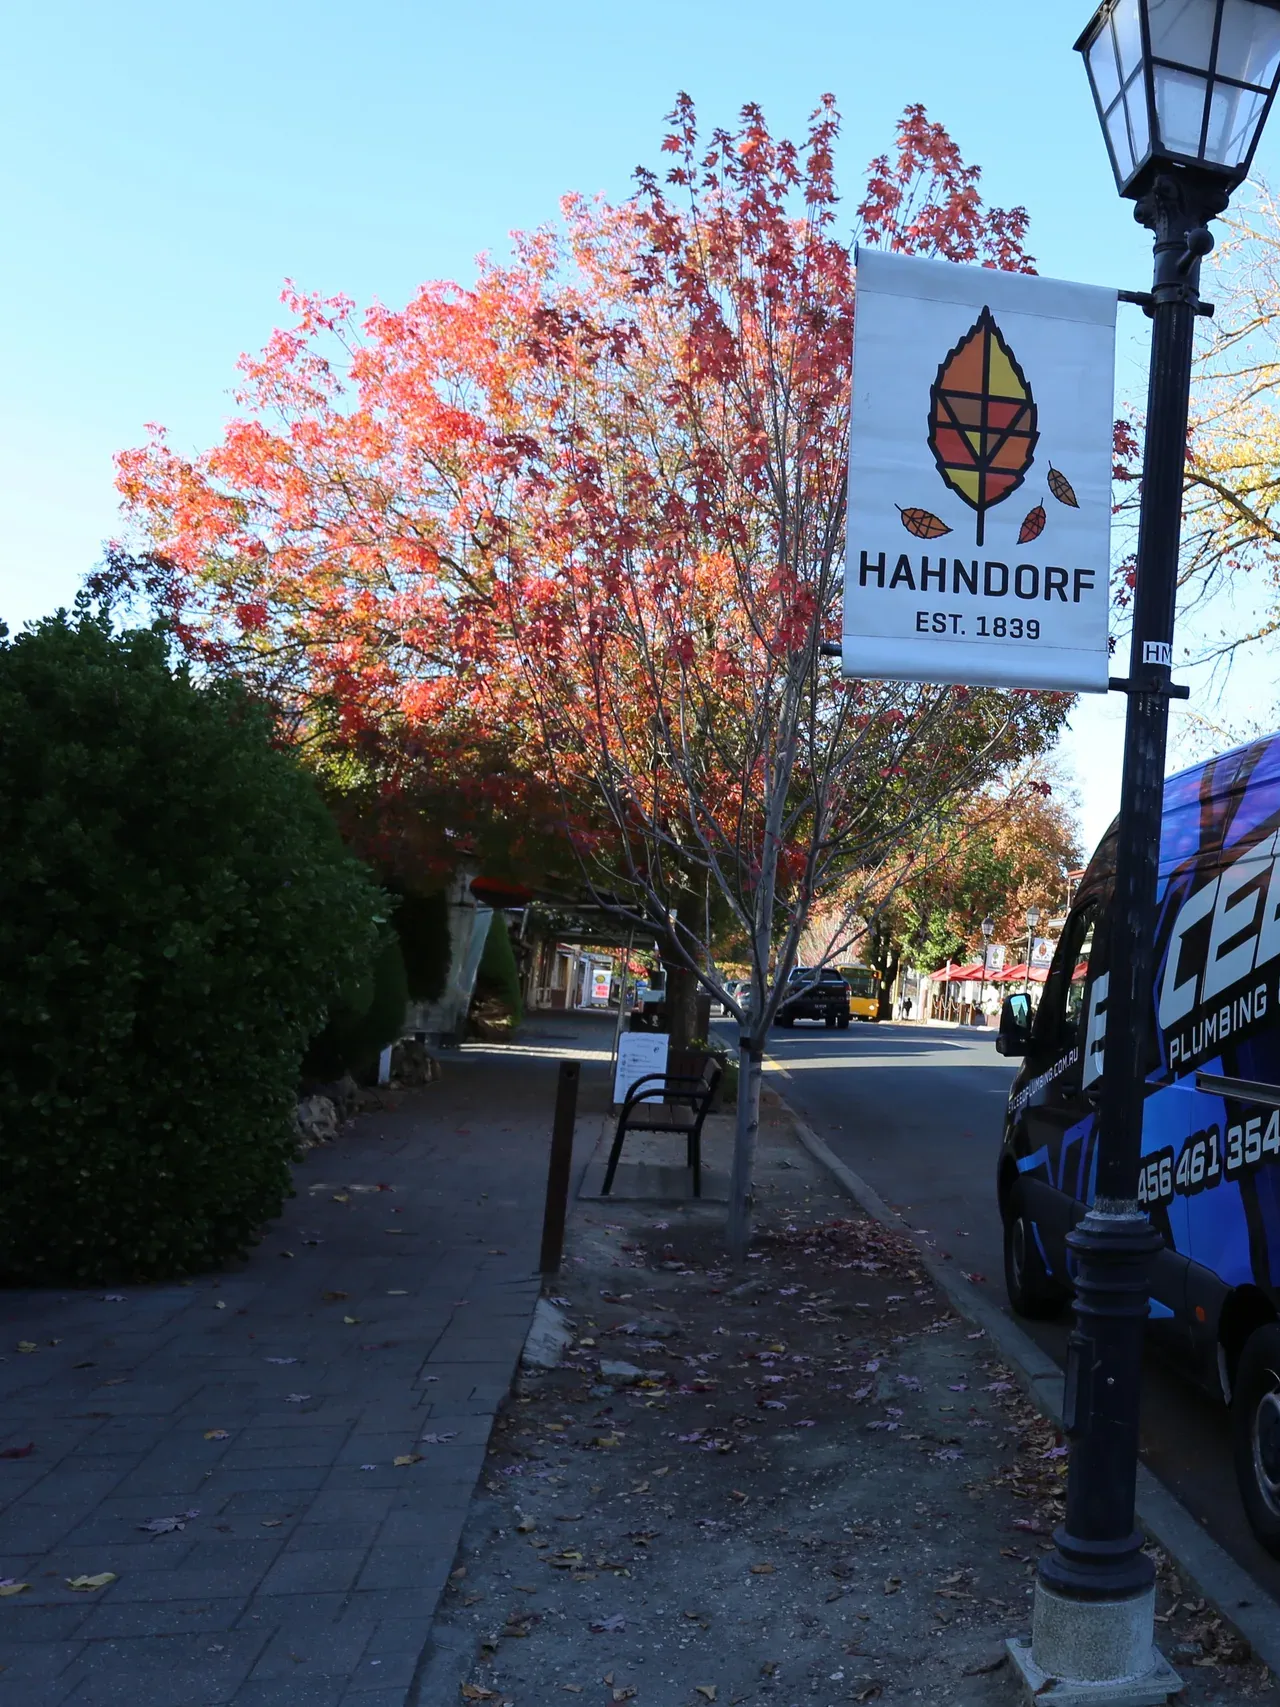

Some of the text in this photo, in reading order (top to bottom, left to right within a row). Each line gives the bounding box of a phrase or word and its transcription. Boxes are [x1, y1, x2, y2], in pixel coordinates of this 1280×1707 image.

[859, 550, 1096, 603] HAHNDORF
[916, 611, 1041, 640] EST. 1839
[1170, 982, 1267, 1069] PLUMBING
[1176, 1134, 1220, 1187] 461
[1227, 1109, 1280, 1170] 354
